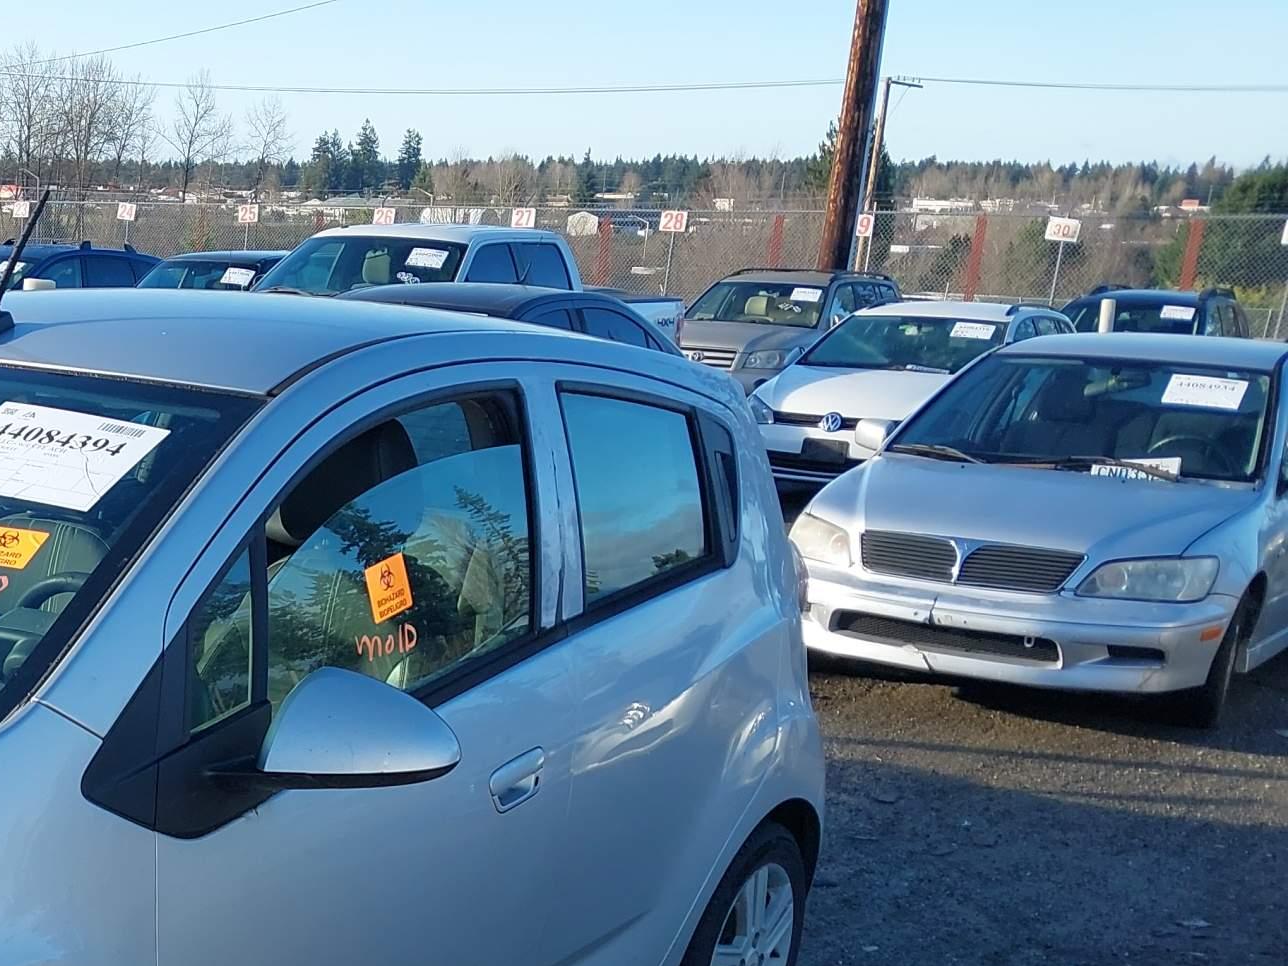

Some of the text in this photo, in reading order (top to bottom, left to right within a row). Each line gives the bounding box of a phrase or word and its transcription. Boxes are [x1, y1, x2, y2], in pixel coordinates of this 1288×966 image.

[14, 203, 28, 216] 23
[118, 205, 133, 219] 24
[240, 206, 256, 220] 25
[376, 209, 393, 224] 26
[515, 209, 530, 226] 27
[662, 213, 684, 230] 28
[1053, 223, 1071, 237] 30
[377, 588, 405, 608] BIOHAZARD
[379, 598, 407, 618] BIOPELIGRO
